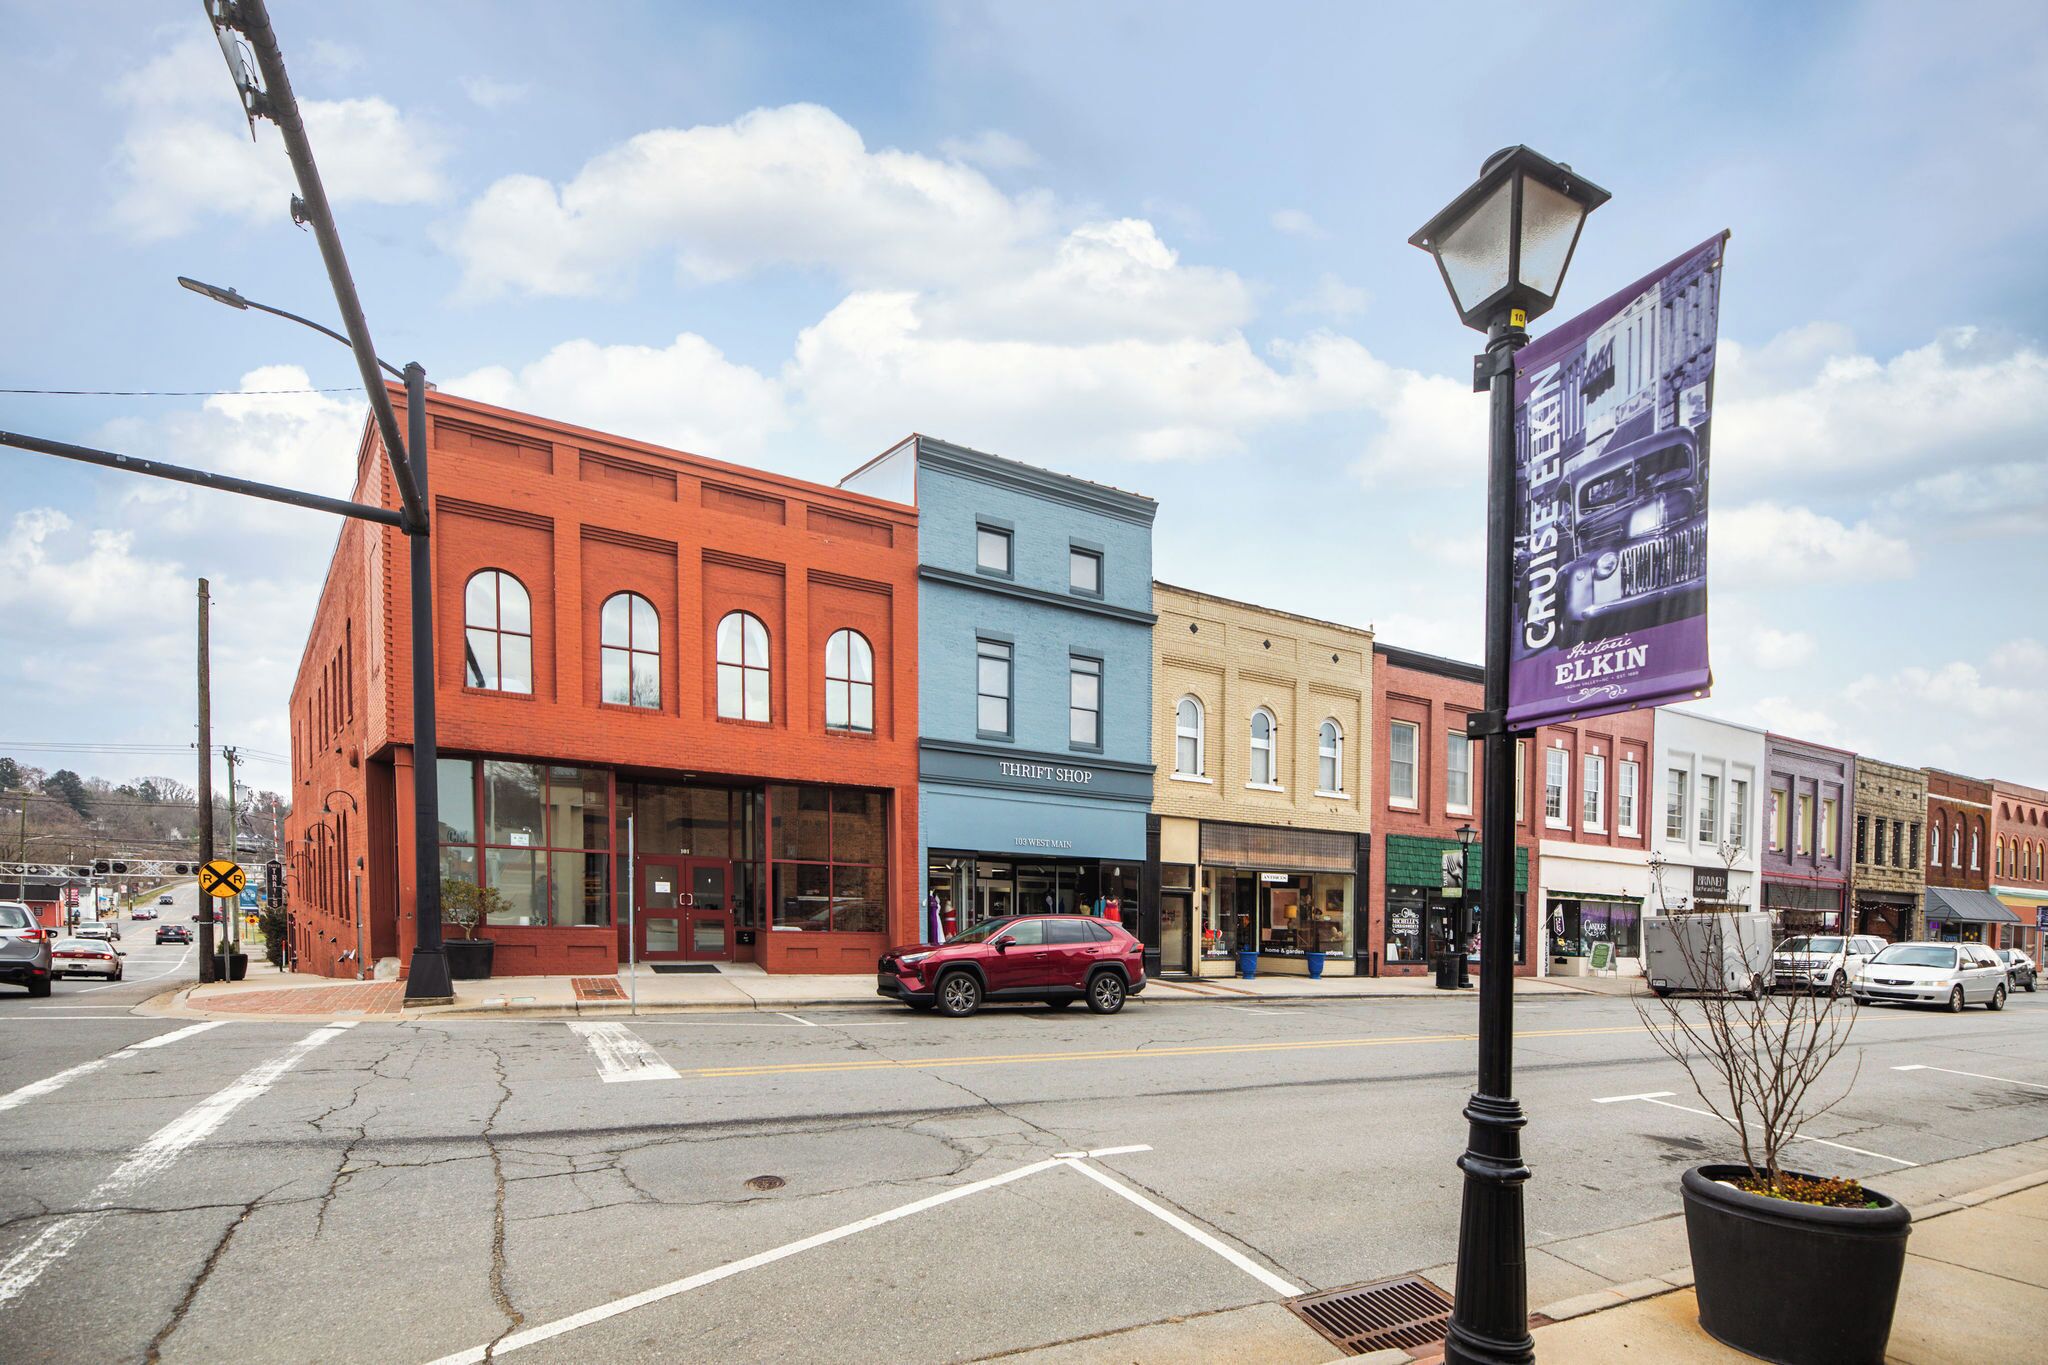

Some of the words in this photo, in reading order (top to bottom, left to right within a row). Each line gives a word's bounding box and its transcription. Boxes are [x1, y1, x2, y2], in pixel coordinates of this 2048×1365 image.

[1514, 313, 1523, 322] 10
[1530, 361, 1561, 489] ELKIN
[1525, 500, 1558, 650] CRUISE
[1566, 633, 1632, 659] Historic
[1555, 644, 1648, 685] ELKIN
[999, 761, 1053, 780] THRIFT
[1056, 768, 1092, 784] SHOP
[1015, 837, 1027, 846] 103
[1028, 838, 1050, 847] WEST
[1051, 839, 1072, 849] MAIN
[203, 874, 213, 884] R
[233, 874, 243, 884] R
